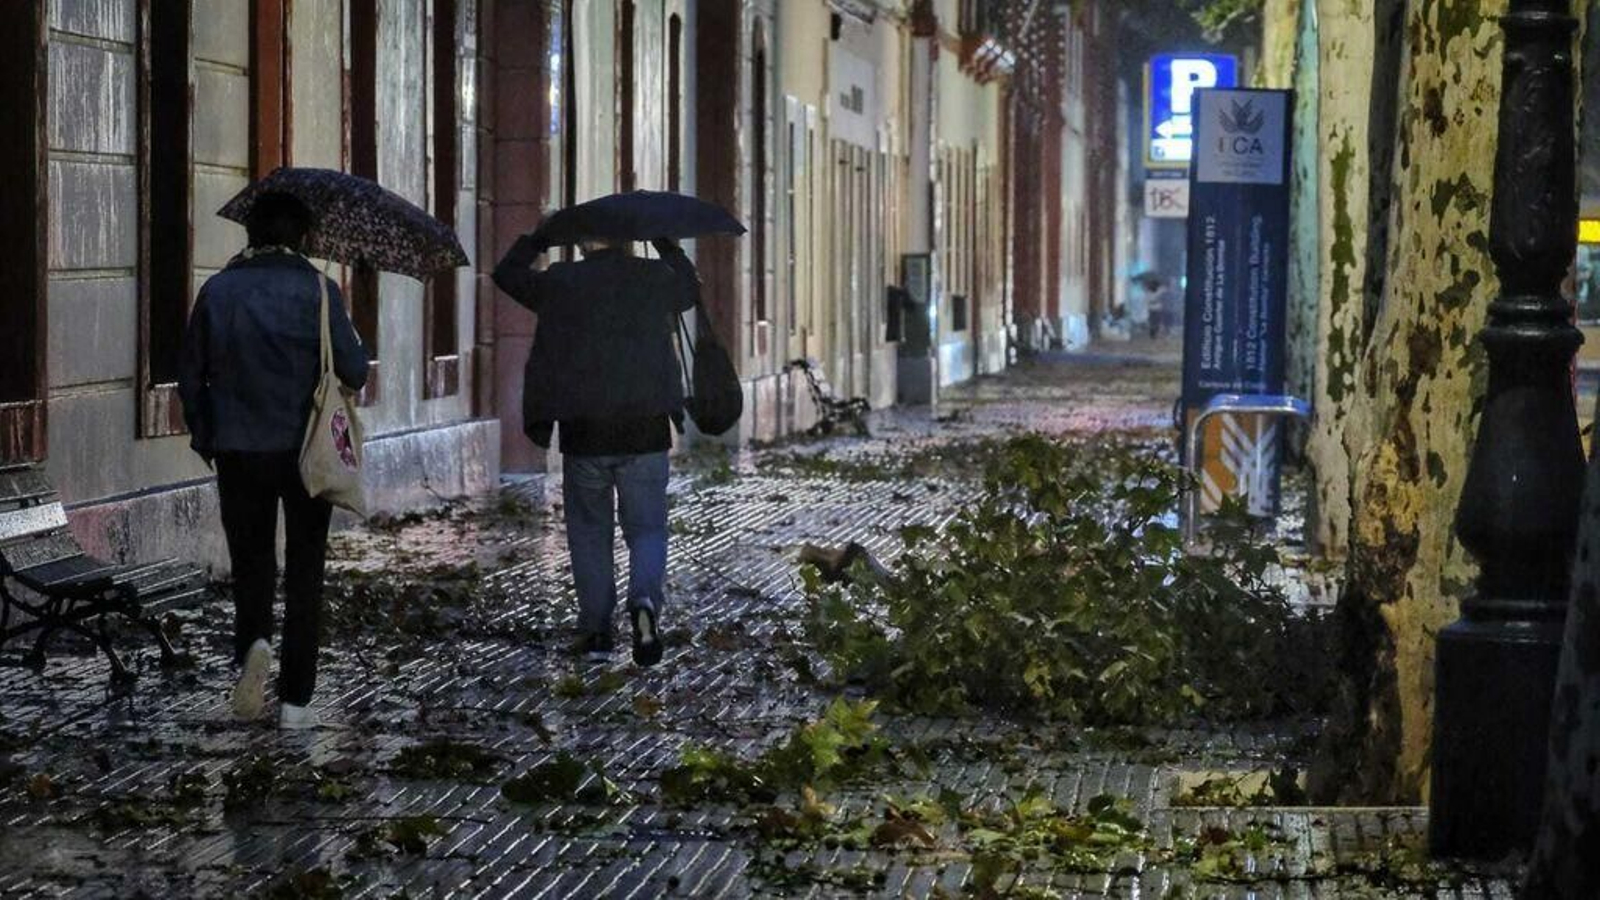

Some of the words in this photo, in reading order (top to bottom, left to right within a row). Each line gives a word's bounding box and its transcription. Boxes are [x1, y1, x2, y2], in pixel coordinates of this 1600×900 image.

[1171, 59, 1217, 114] P
[1205, 216, 1215, 244] 1812
[1201, 324, 1213, 370] Edificio
[1247, 342, 1256, 370] 1812
